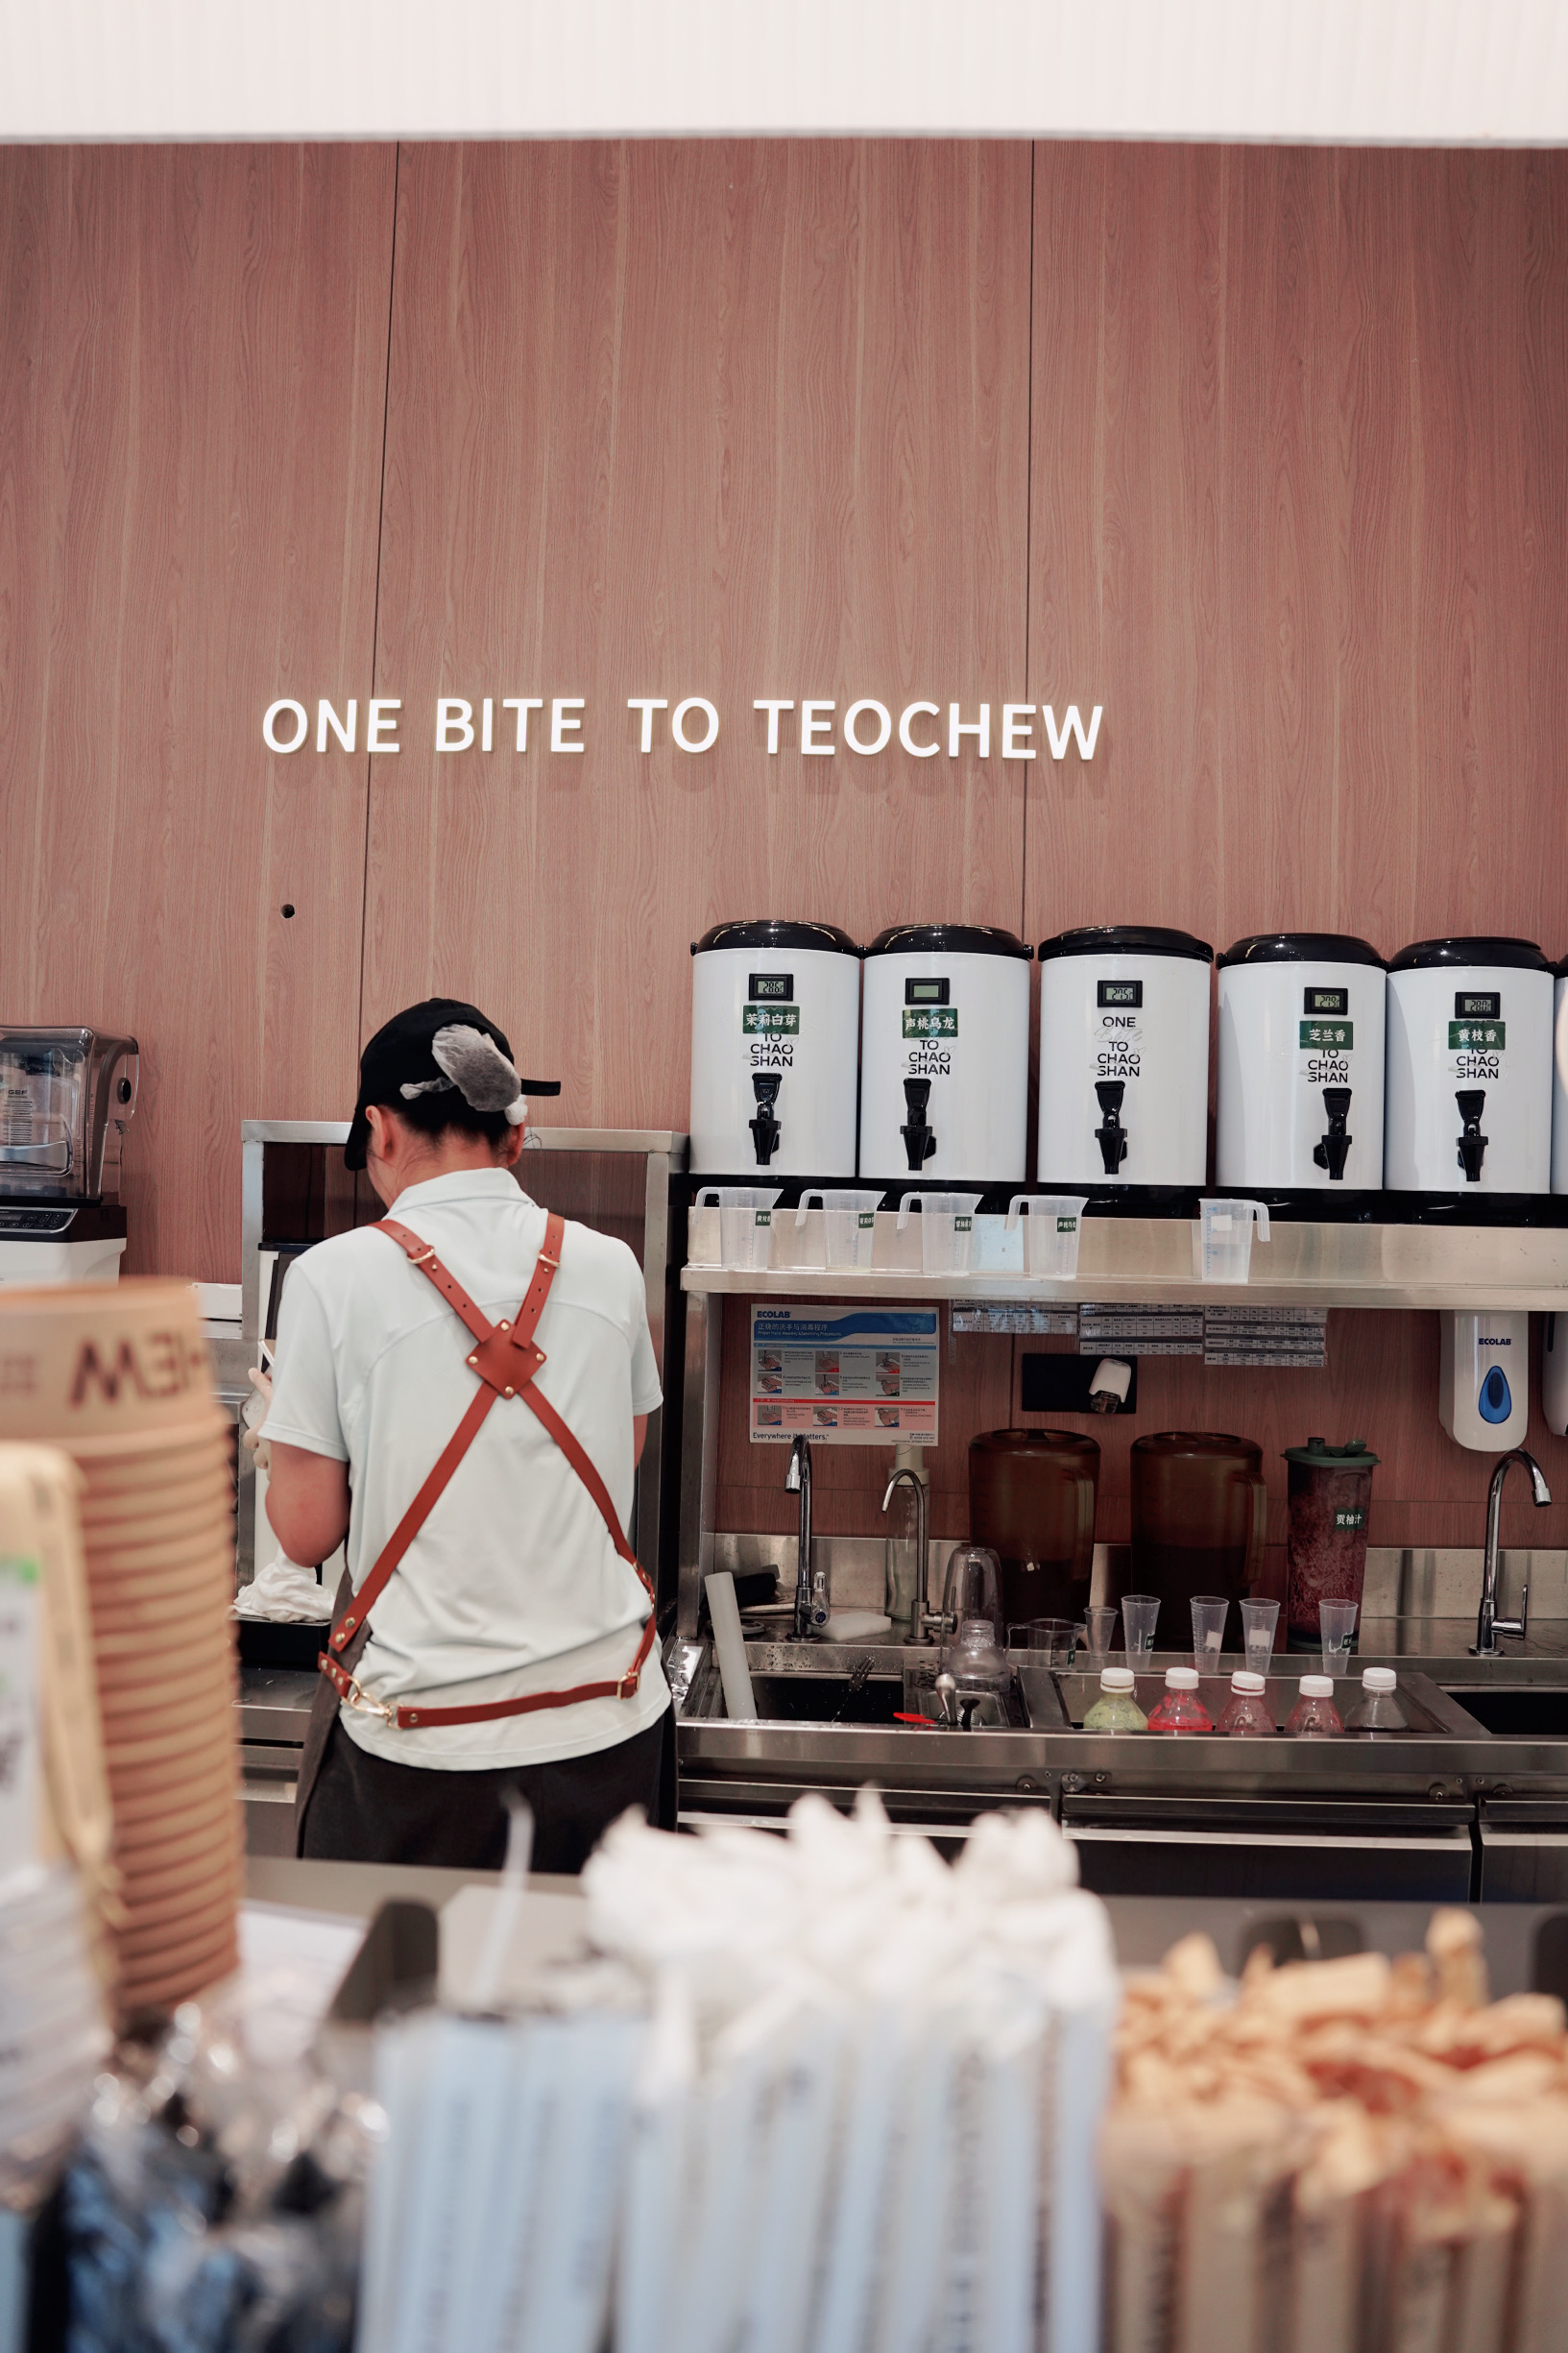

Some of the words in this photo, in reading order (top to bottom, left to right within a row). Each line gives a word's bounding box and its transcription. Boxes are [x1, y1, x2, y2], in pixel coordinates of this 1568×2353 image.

[262, 698, 402, 754] ONE
[435, 697, 586, 753] BITE
[627, 696, 719, 754] TO
[753, 698, 1103, 761] TEOCHEW
[745, 1012, 797, 1027] 茉莉白芽
[905, 1016, 955, 1031] 声桃乌龙
[1102, 1016, 1137, 1028] ONE
[1309, 1028, 1346, 1042] 芝兰香
[1458, 1028, 1497, 1042] 黄枝香
[750, 1043, 794, 1055] CHAO
[919, 1039, 939, 1051] TO
[1108, 1041, 1129, 1052] TO
[750, 1055, 793, 1067] SHAN
[908, 1052, 952, 1063] CHAO
[1097, 1053, 1141, 1064] CHAO
[1456, 1055, 1500, 1067] CHAO
[908, 1063, 951, 1075] SHAN
[1097, 1065, 1141, 1077] SHAN
[1307, 1059, 1349, 1071] CHAO
[1307, 1072, 1348, 1083] SHAN
[1456, 1068, 1499, 1079] SHAN
[753, 1432, 792, 1441] Everywhere
[1336, 1514, 1363, 1525] 贡柚汁
